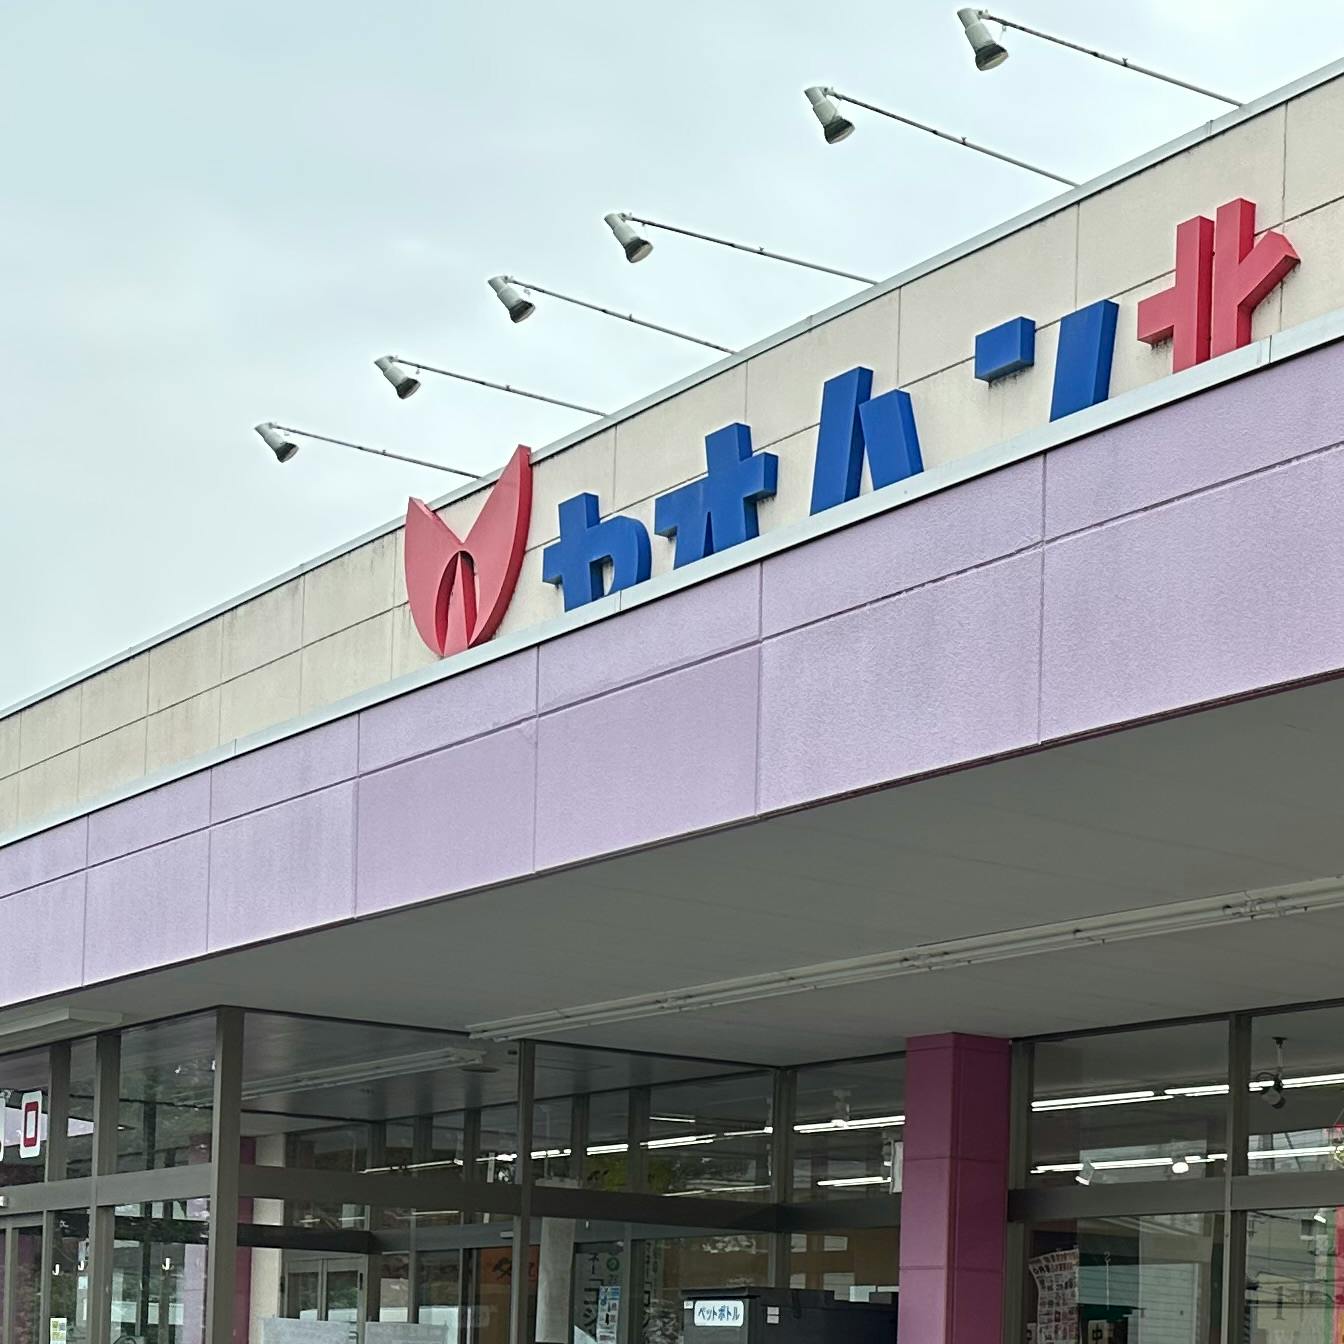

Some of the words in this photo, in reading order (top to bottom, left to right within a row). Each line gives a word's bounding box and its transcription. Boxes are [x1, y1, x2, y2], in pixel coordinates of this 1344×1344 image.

[698, 1305, 740, 1321] ペットボトル
